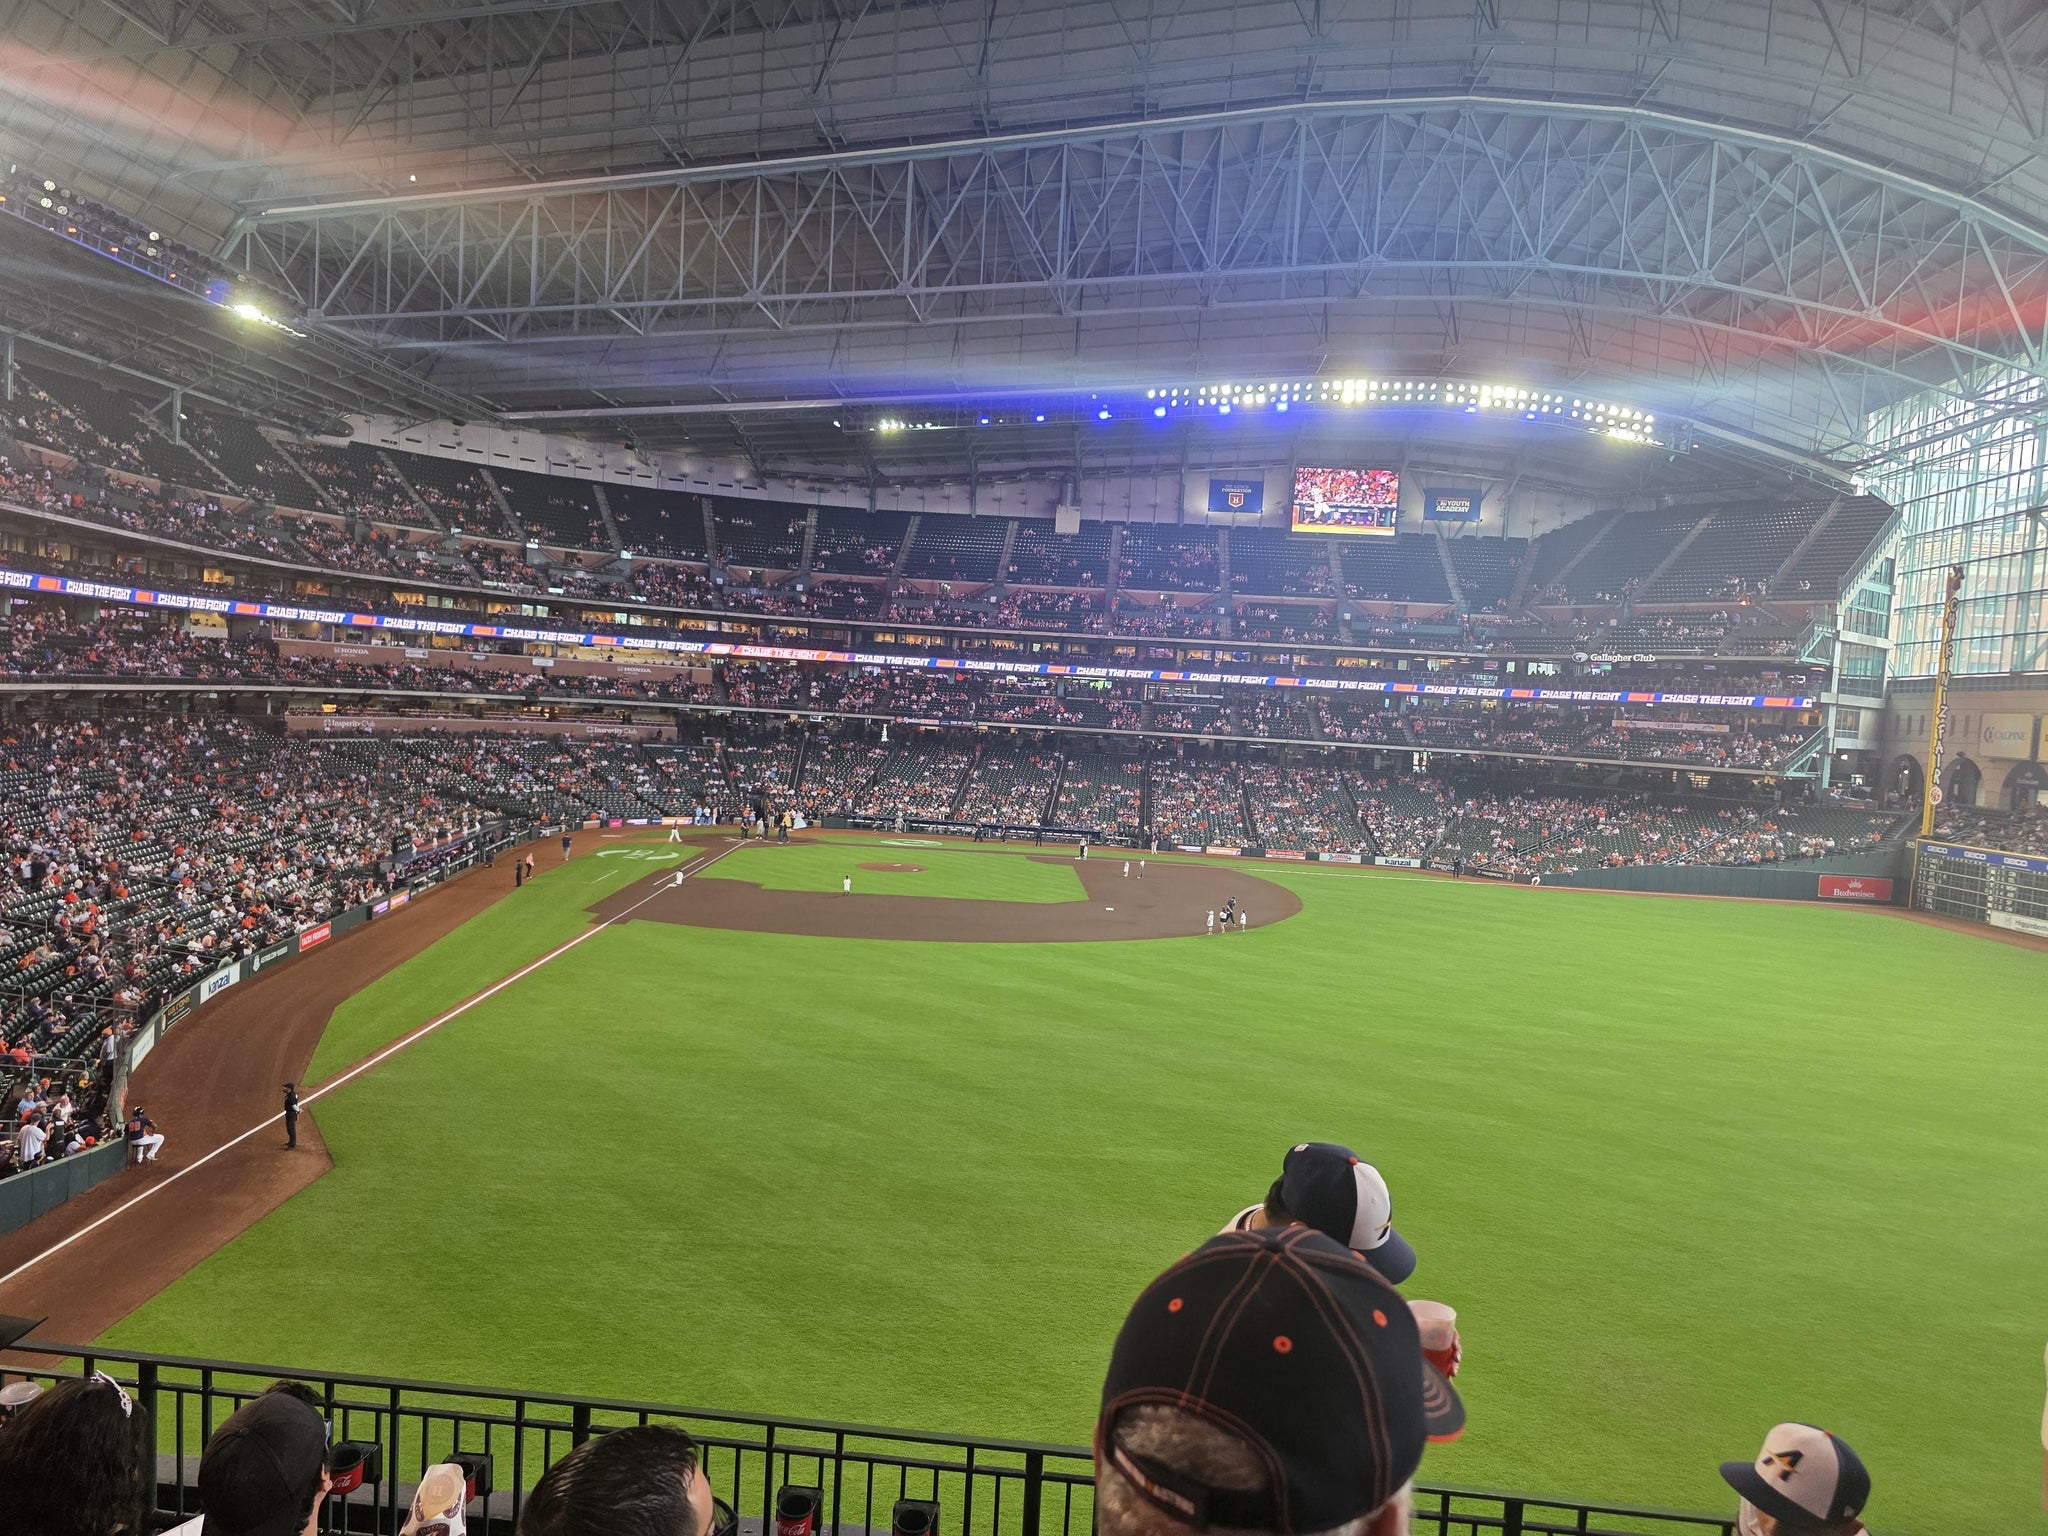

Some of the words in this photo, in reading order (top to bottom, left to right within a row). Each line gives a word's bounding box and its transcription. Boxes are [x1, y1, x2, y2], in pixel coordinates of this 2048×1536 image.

[1436, 505, 1469, 513] ACADEMY
[4, 573, 33, 587] FIGHT
[66, 581, 94, 595] CHASE
[94, 585, 109, 598] THE
[110, 587, 131, 600] FIGHT
[158, 594, 189, 607] CHASE
[189, 598, 206, 609] THE
[206, 600, 230, 611] FIGHT
[266, 606, 298, 618] CHASE
[299, 610, 317, 620] THE
[317, 612, 346, 622] FIGHT
[383, 618, 415, 629] CHASE
[417, 621, 436, 633] THE
[436, 623, 466, 633] FIGHT
[503, 629, 537, 639] CHASE
[538, 631, 558, 641] THE
[558, 633, 586, 642] FIGHT
[623, 638, 656, 648] CHASE
[656, 641, 675, 649] THE
[675, 643, 705, 651] FIGHT
[340, 647, 369, 655] HONDA
[741, 646, 773, 657] CHASE
[774, 648, 792, 658] THE
[792, 650, 820, 658] FIGHT
[854, 654, 885, 664] CHASE
[885, 656, 903, 665] THE
[903, 658, 930, 666] FIGHT
[1590, 653, 1633, 663] Gallagher
[1633, 654, 1656, 662] Club
[965, 661, 996, 670] CHASE
[997, 663, 1015, 671] THE
[1015, 664, 1041, 672] FIGHT
[1076, 667, 1108, 676] CHASE
[1108, 669, 1126, 677] THE
[1126, 670, 1154, 678] FIGHT
[1189, 673, 1222, 681] CHASE
[1222, 675, 1241, 683] THE
[1241, 676, 1268, 684] FIGHT
[1305, 679, 1338, 688] CHASE
[1338, 681, 1357, 689] THE
[1358, 682, 1387, 690] FIGHT
[1424, 686, 1457, 695] CHASE
[1458, 687, 1477, 695] THE
[1477, 688, 1505, 697] FIGHT
[1540, 691, 1572, 699] CHASE
[1572, 692, 1591, 700] THE
[1591, 692, 1621, 700] FIGHT
[1662, 694, 1699, 703] CHASE
[1699, 695, 1721, 704] THE
[1721, 697, 1755, 705] FIGHT
[1833, 888, 1876, 898] Budweiser
